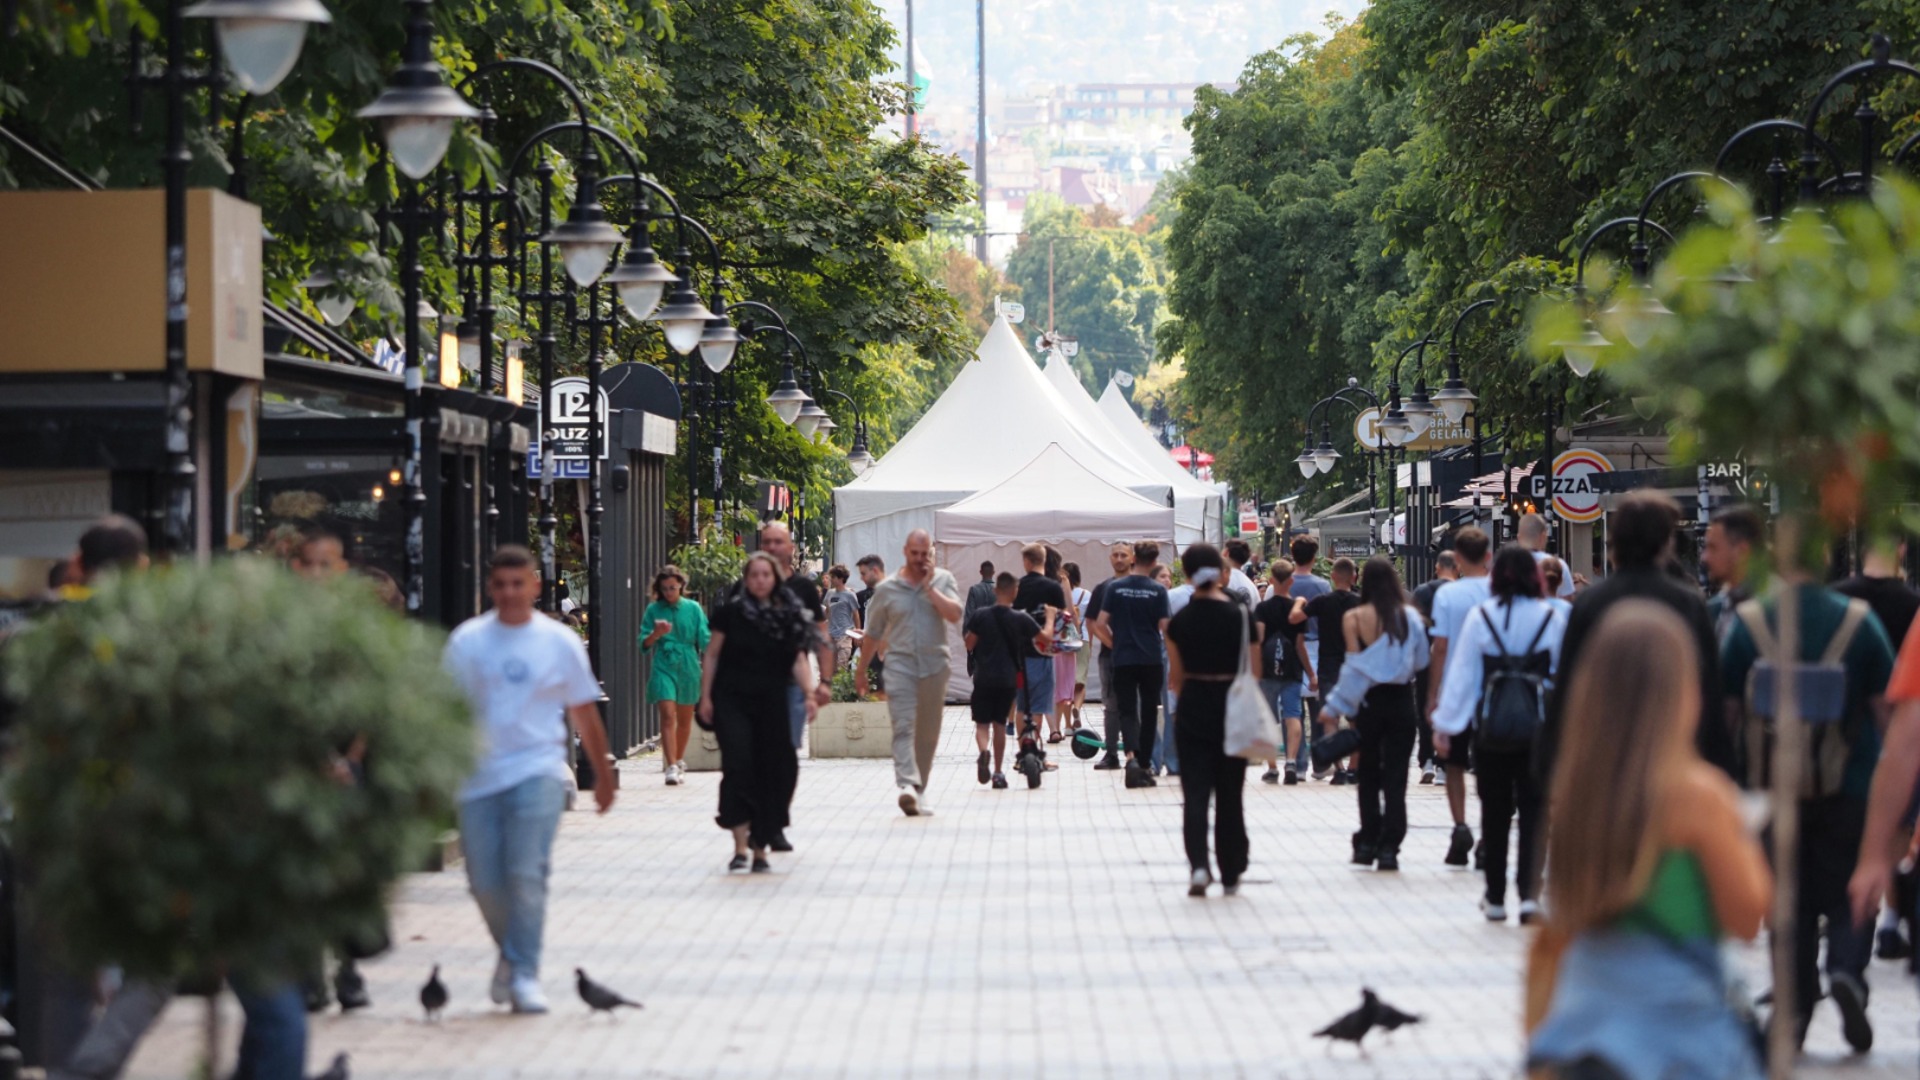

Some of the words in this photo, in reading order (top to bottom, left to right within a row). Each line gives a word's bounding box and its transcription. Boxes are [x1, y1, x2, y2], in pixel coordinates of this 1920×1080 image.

[558, 392, 590, 417] 12
[1430, 418, 1451, 428] BAR
[1430, 429, 1472, 440] GELATO
[1707, 463, 1741, 477] BAR
